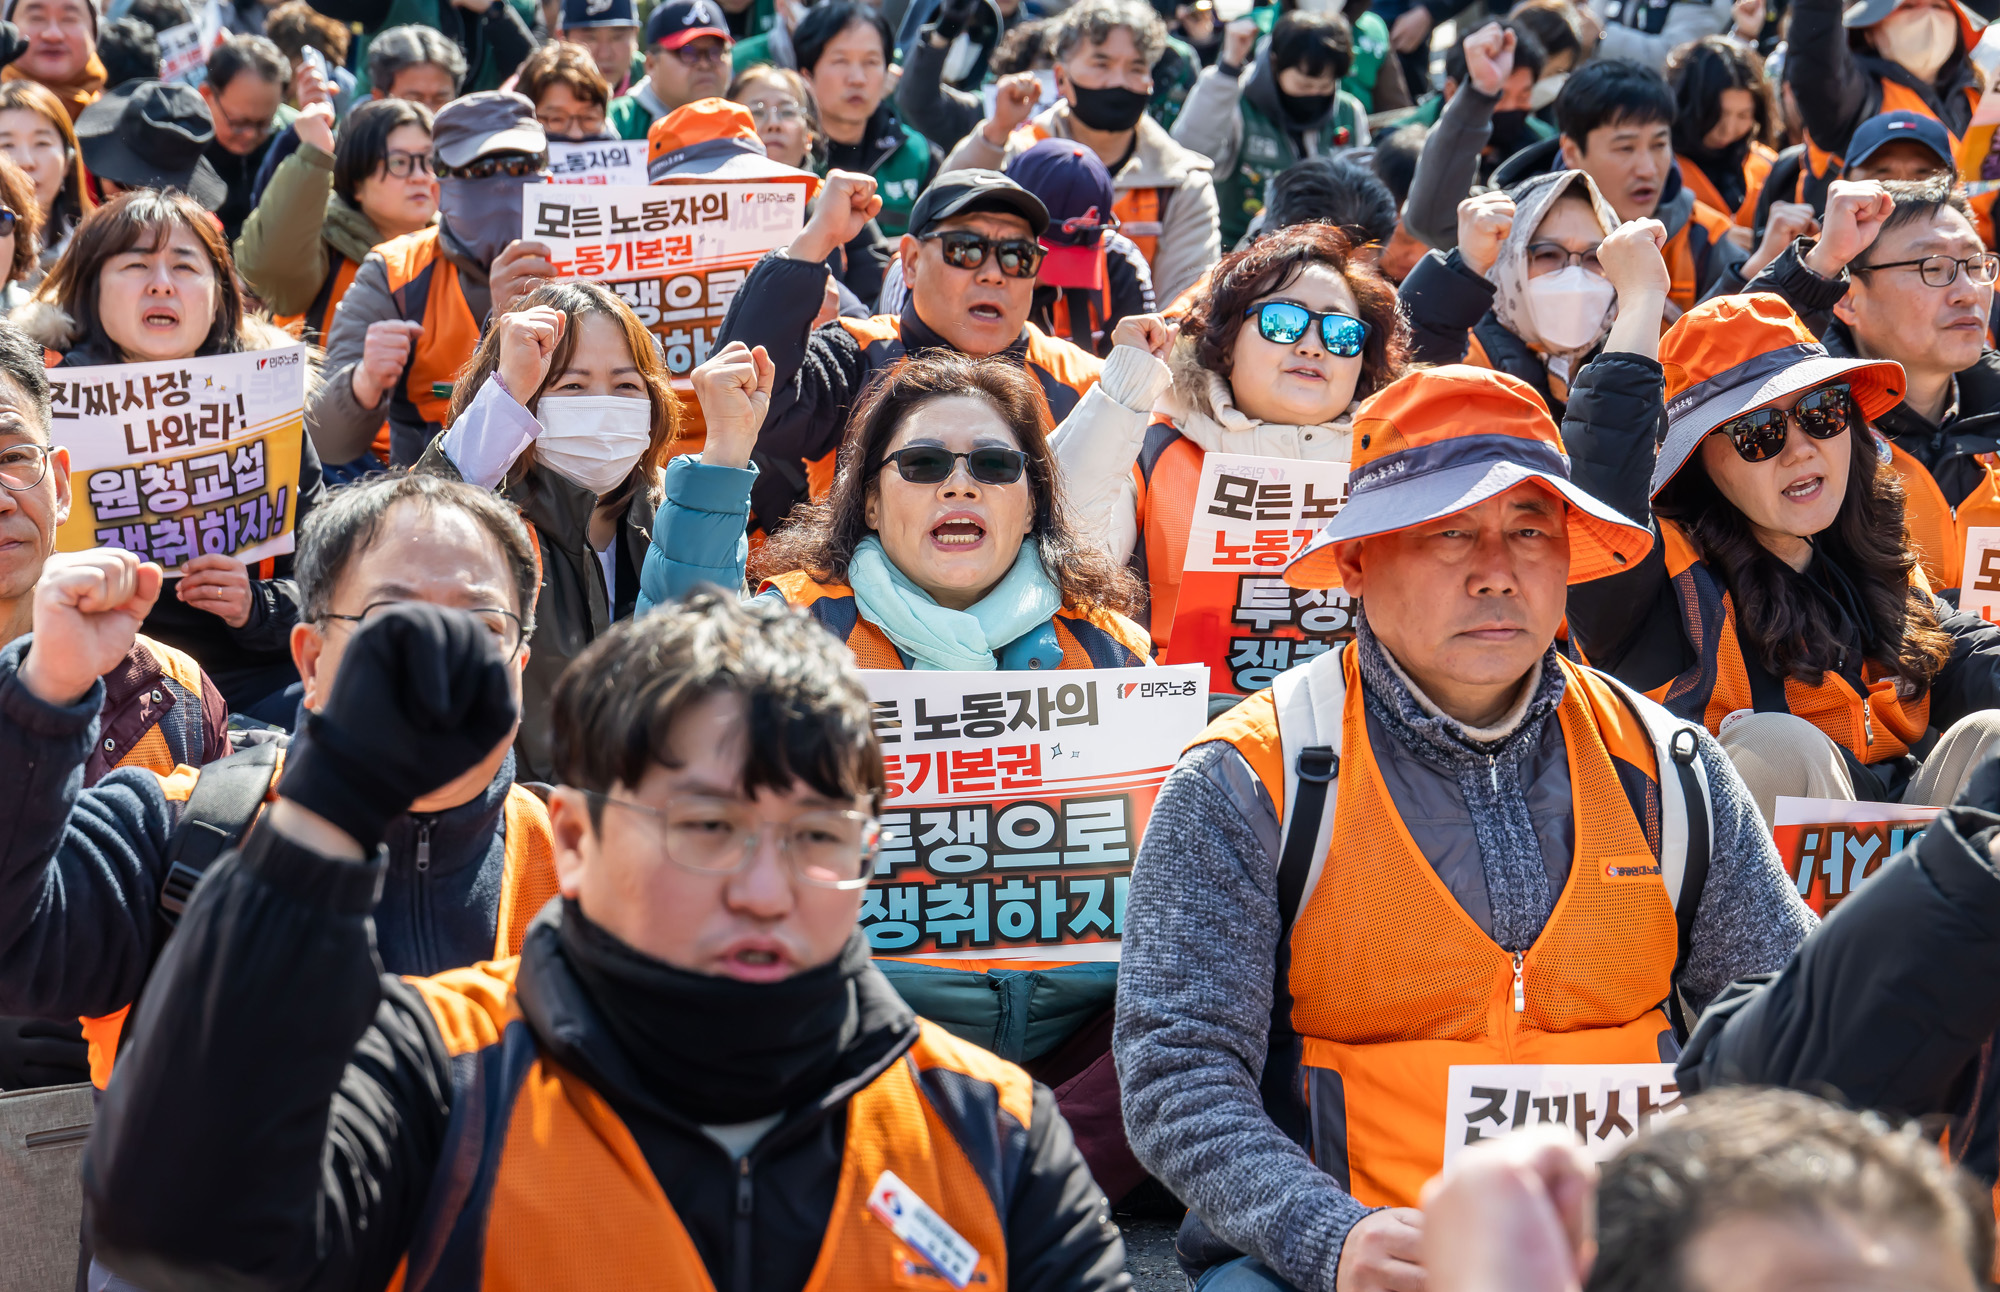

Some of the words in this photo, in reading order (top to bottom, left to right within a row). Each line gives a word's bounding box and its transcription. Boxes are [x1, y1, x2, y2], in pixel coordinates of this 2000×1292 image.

[534, 201, 602, 239] 모든
[610, 191, 729, 233] 노동자의
[269, 352, 300, 369] 민주노총
[50, 369, 192, 420] 진짜사장
[123, 393, 247, 456] 나와라!
[90, 440, 266, 521] 원청교섭
[1207, 473, 1293, 521] 모든
[1301, 483, 1350, 519] 노
[95, 486, 288, 567] 쟁취하자!
[1235, 577, 1357, 631] 투쟁
[913, 680, 1100, 742] 노동자의
[1140, 680, 1197, 699] 민주노총
